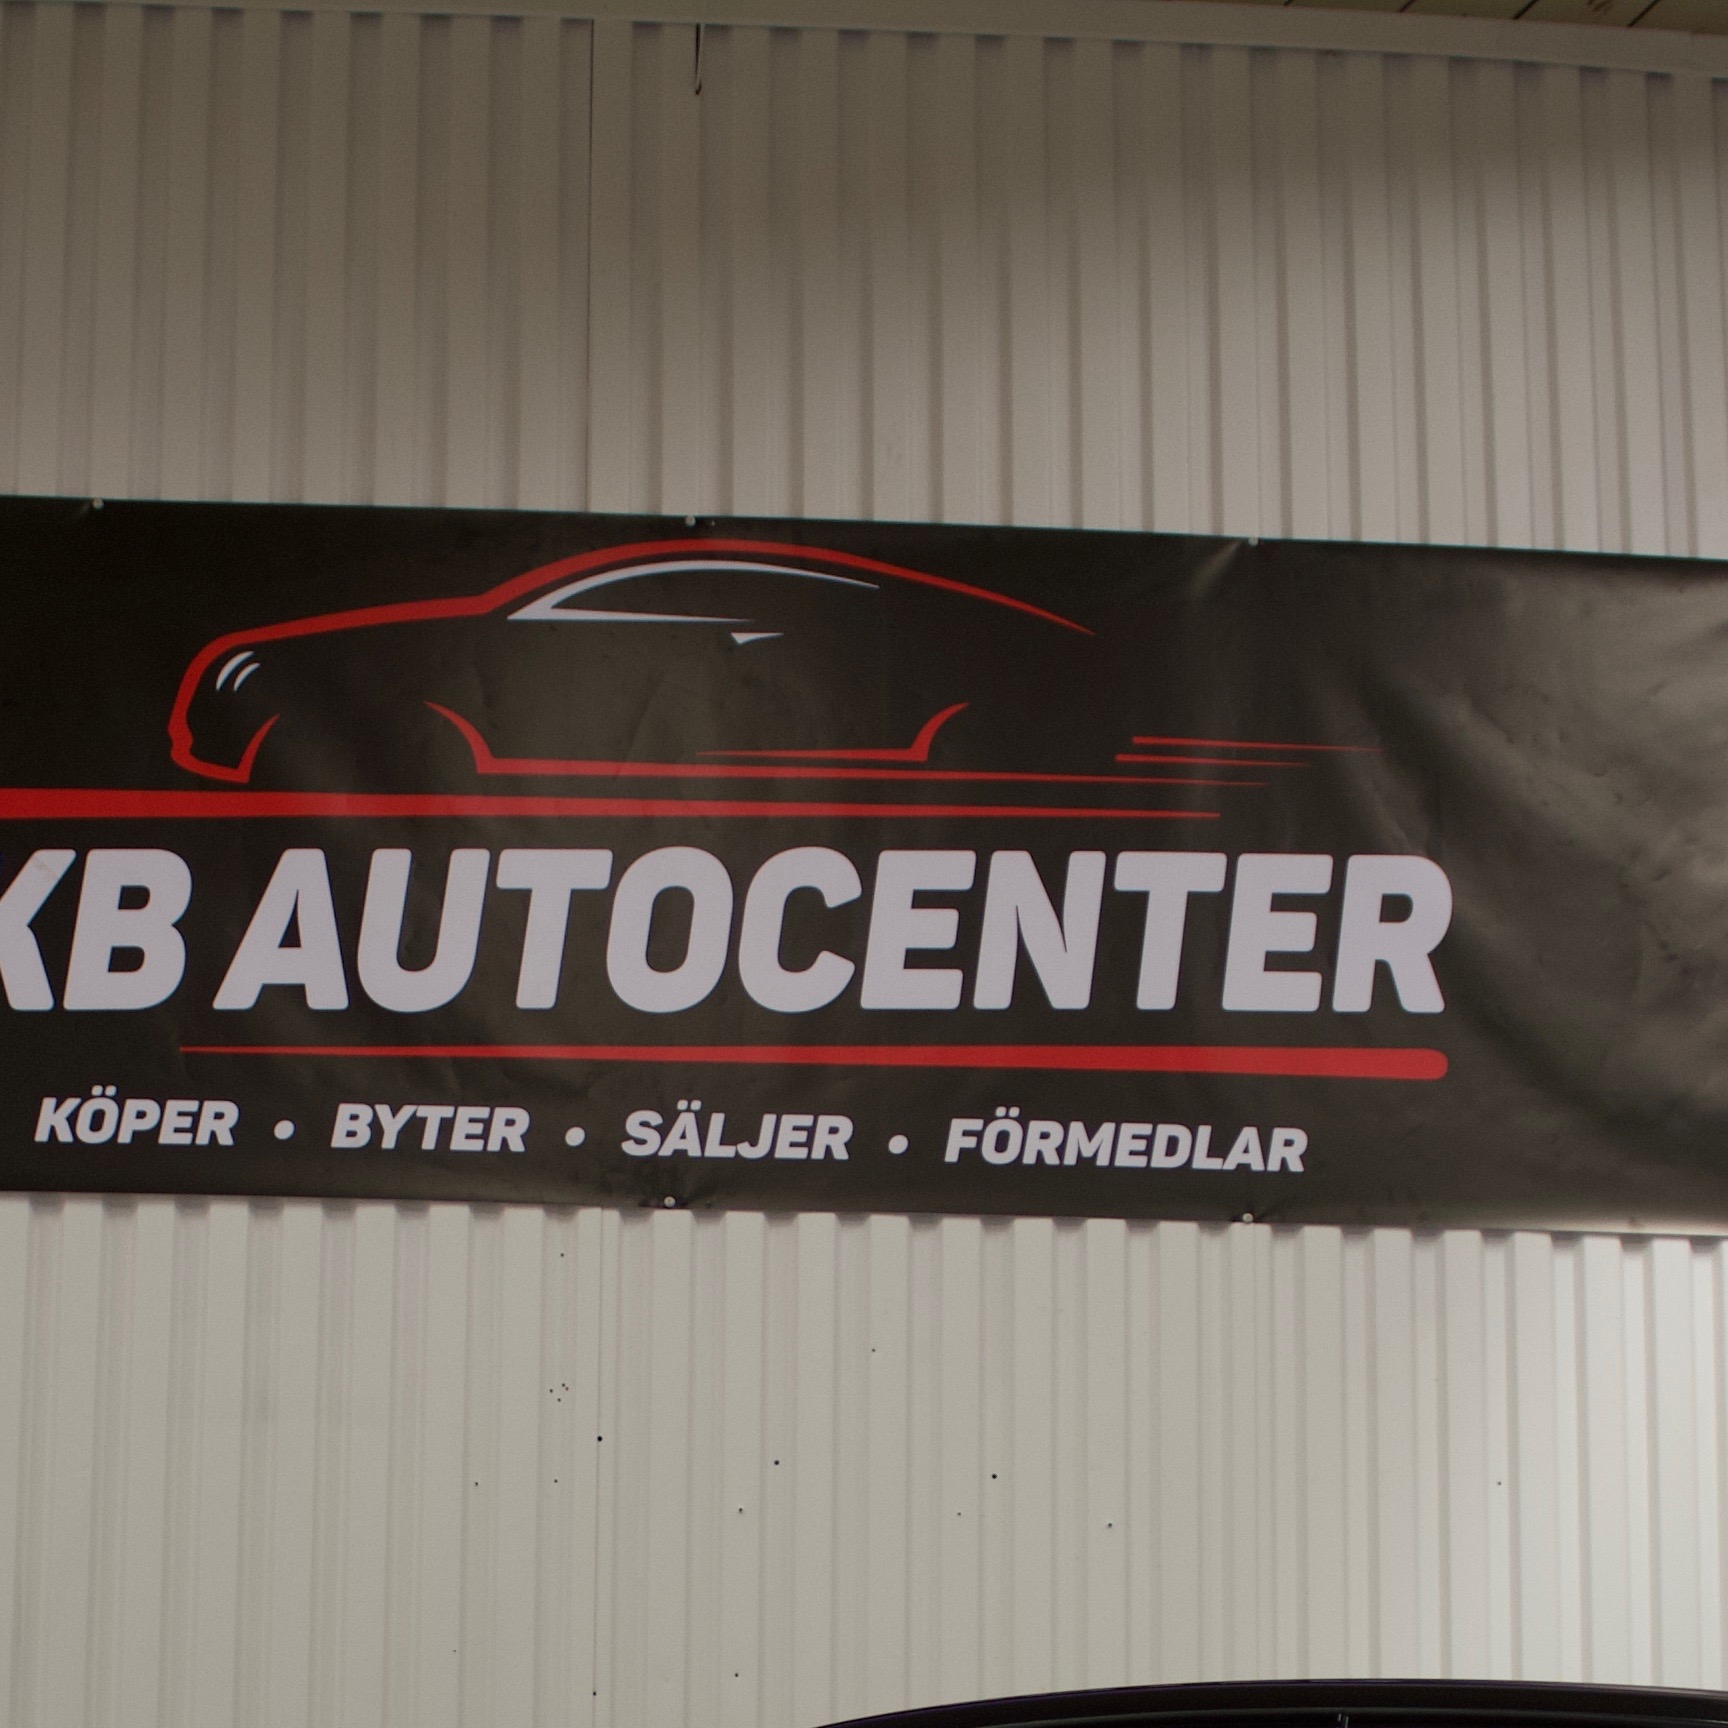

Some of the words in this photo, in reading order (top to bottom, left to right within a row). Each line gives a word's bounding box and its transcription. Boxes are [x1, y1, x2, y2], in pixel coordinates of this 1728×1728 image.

[212, 845, 1454, 1014] AUTOCENTER
[33, 1084, 240, 1147] KÖPER
[329, 1102, 531, 1153] BYTER
[620, 1098, 855, 1161] SÄLJER
[943, 1105, 1309, 1174] FÖRMEDLAR
